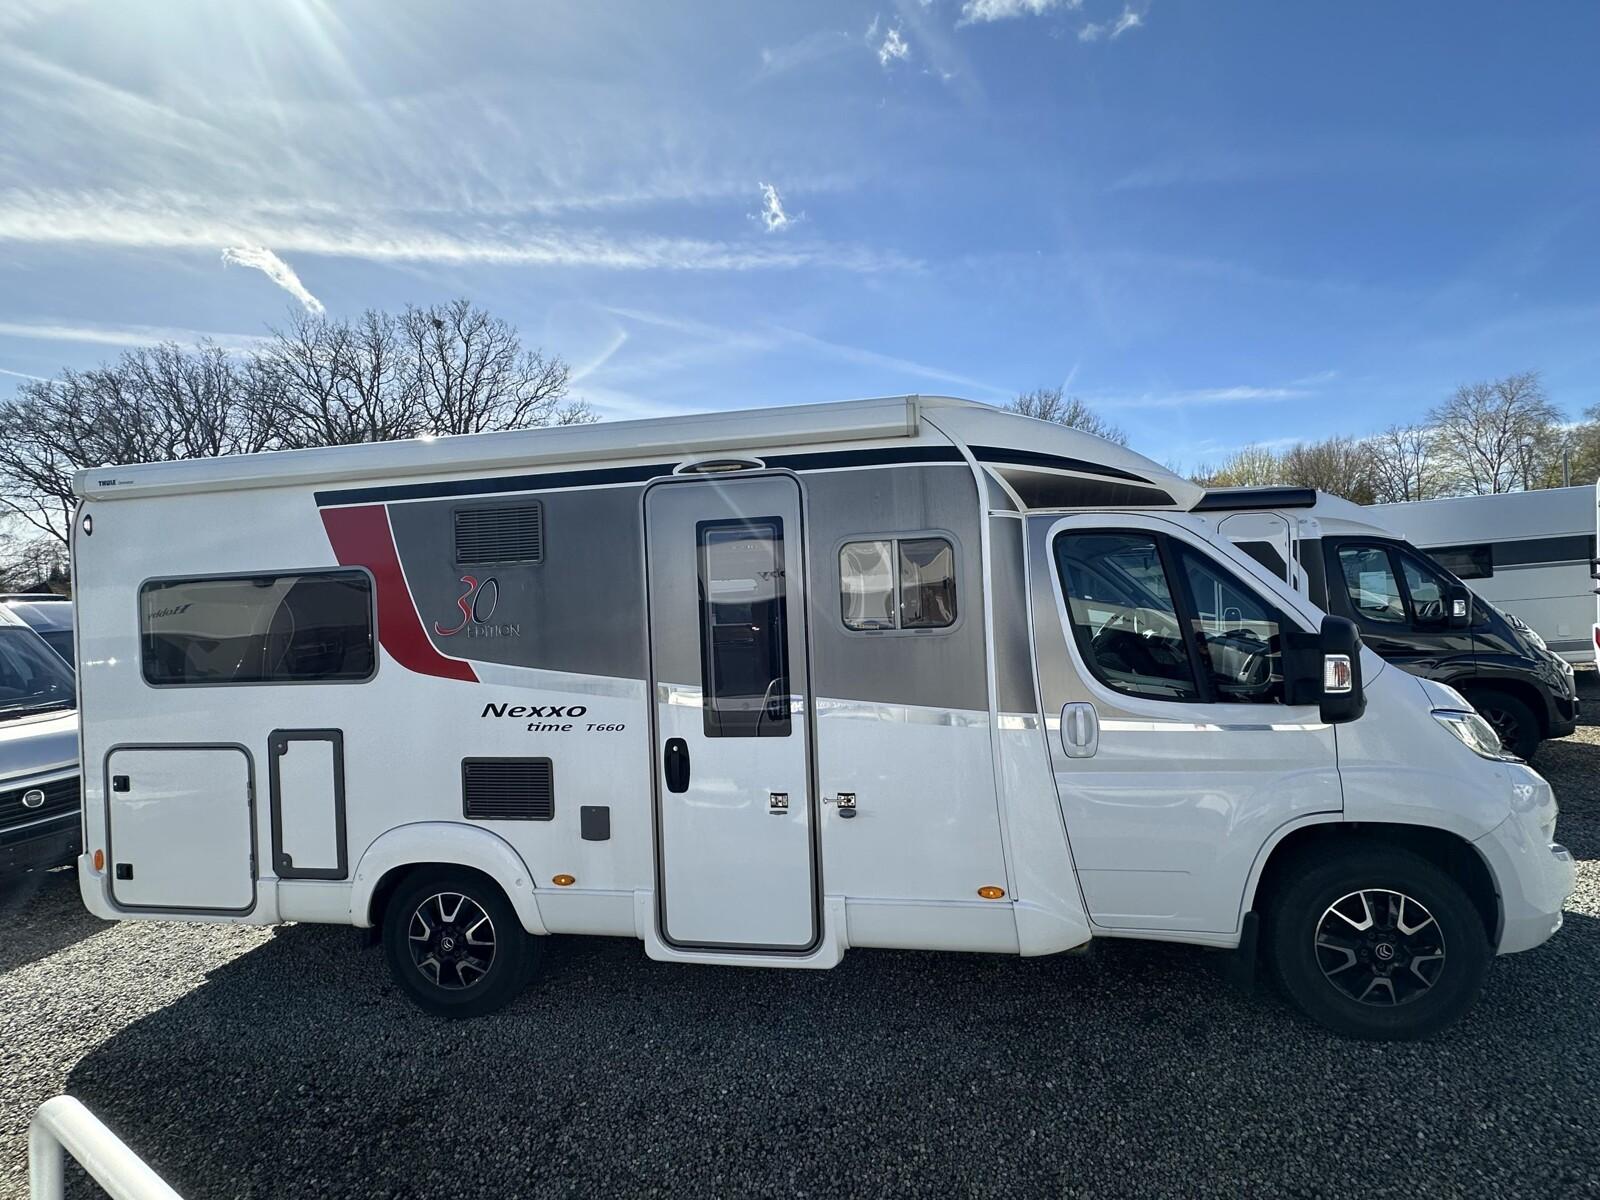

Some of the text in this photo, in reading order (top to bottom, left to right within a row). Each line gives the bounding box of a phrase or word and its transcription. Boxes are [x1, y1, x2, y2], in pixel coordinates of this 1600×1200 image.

[434, 575, 500, 636] 30
[466, 623, 521, 639] EDITION
[481, 702, 588, 718] Nexxo
[526, 721, 626, 732] time T660
